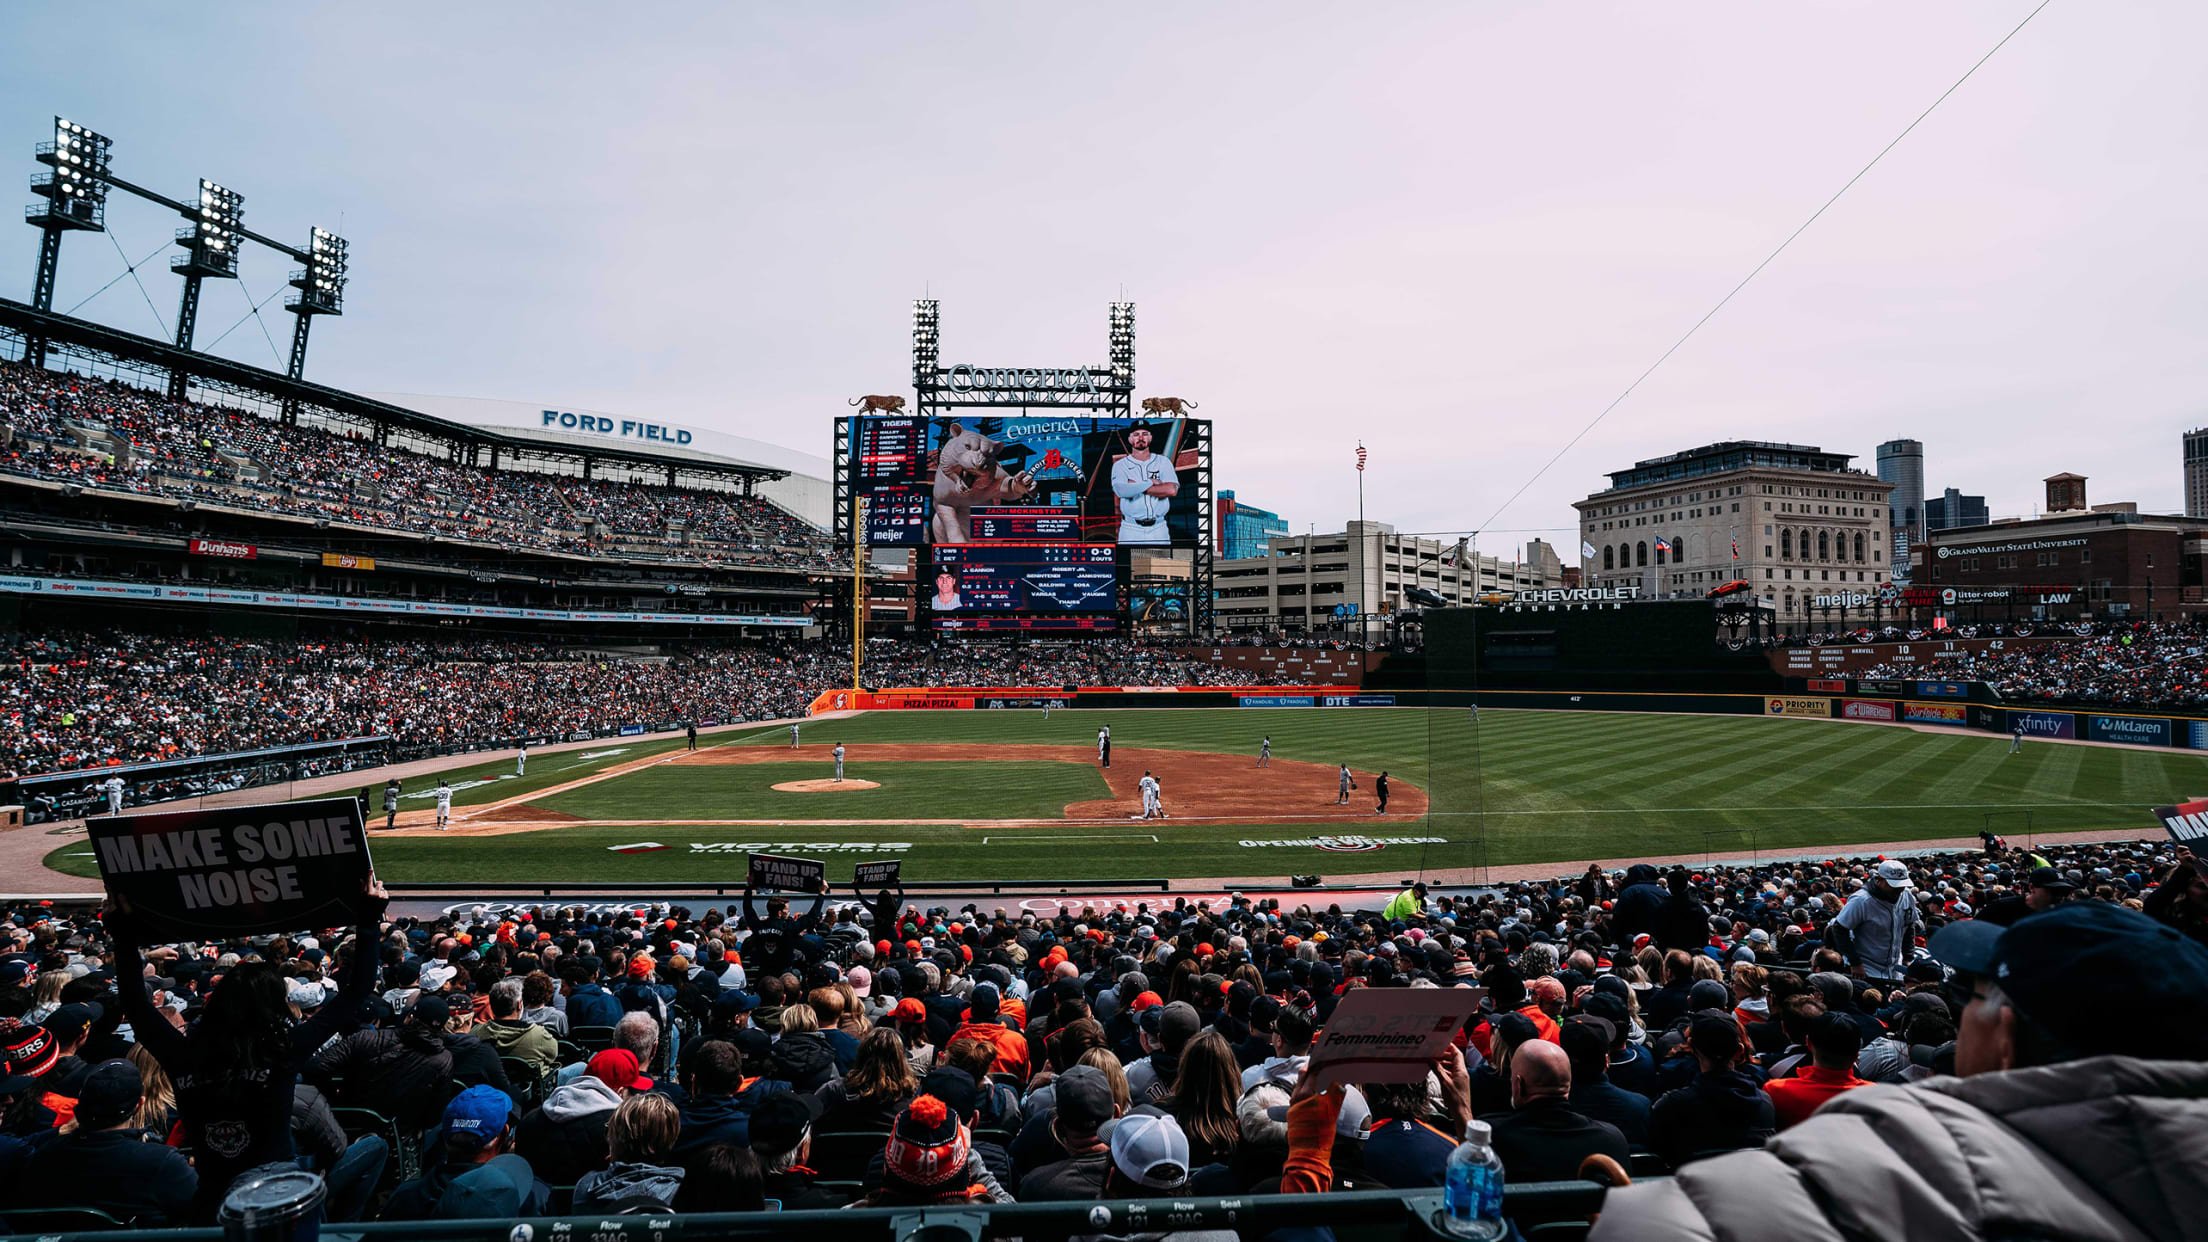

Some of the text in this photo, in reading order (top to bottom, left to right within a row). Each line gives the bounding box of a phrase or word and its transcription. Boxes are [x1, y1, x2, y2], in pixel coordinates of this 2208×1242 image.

[989, 391, 1057, 402] PARK
[542, 409, 692, 445] FORD FIELD
[873, 529, 903, 542] meijer
[198, 540, 249, 556] Dunham's
[1949, 538, 2089, 556] GRAND VALLEY STATE UNIVERSITY
[1521, 586, 1641, 602] CHEVROLET
[1815, 590, 1870, 609] meijer
[1958, 590, 2009, 598] litter-robot
[2040, 594, 2071, 604] LAW
[1499, 603, 1622, 613] FOUNTAIN
[942, 620, 963, 628] meijer
[1898, 645, 1910, 654] 10
[1944, 642, 1954, 651] 11
[1990, 640, 2004, 650] 42
[903, 699, 959, 708] PIZZA! PIZZA!
[1326, 697, 1350, 706] DTE
[1786, 700, 1825, 708] PRIORITY
[1909, 705, 1942, 719] Surfside
[2018, 714, 2063, 735] xfinity
[2114, 720, 2161, 734] McLaren
[2109, 733, 2132, 741] HEALTH
[98, 816, 356, 874] MAKE SOME
[752, 859, 820, 878] STAND UP
[857, 863, 898, 876] STAND UP
[765, 873, 804, 888] FANS!
[863, 872, 887, 883] FANS!
[178, 865, 304, 910] NOISE
[1324, 1031, 1426, 1047] Femminineo
[1128, 1199, 1242, 1214] Sec Row Seat
[553, 1218, 671, 1232] Sec Row Seat
[1126, 1215, 1149, 1228] 121
[1167, 1212, 1203, 1225] 33AC
